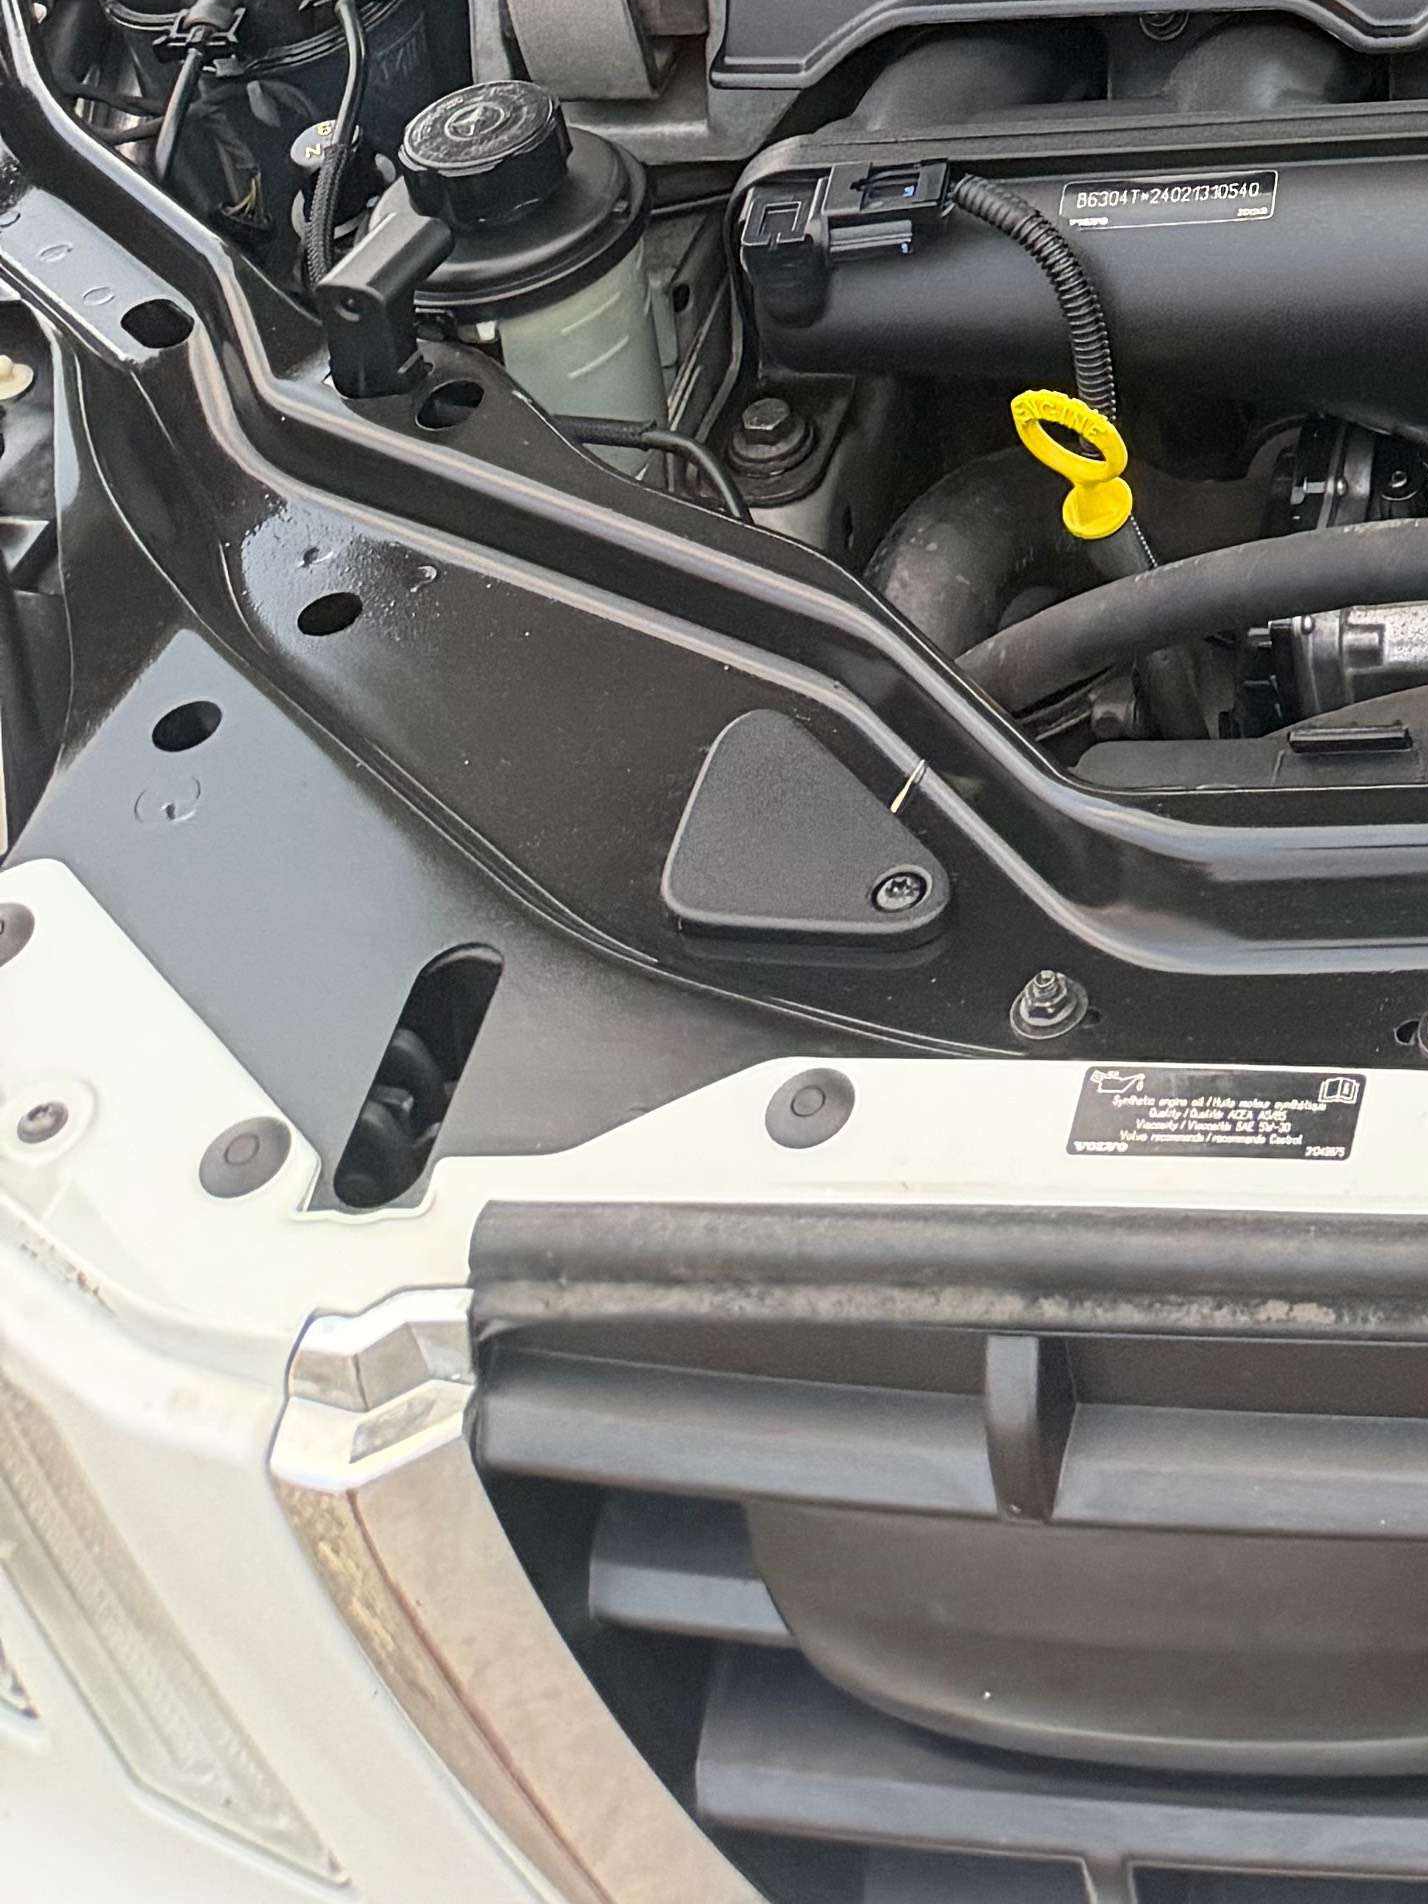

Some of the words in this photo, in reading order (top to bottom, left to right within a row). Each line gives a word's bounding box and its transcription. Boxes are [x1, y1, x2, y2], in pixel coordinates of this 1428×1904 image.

[1013, 398, 1106, 436] ENGINE
[1159, 1097, 1187, 1107] engine
[1191, 1096, 1203, 1106] oil
[1149, 1107, 1181, 1120] Quality
[1227, 1110, 1253, 1120] ACEA
[1136, 1118, 1179, 1131] Viscosity
[1235, 1121, 1255, 1132] SAE
[1120, 1130, 1148, 1142] Volvo
[1269, 1134, 1303, 1145] Castrol
[1073, 1141, 1129, 1152] VOLVO
